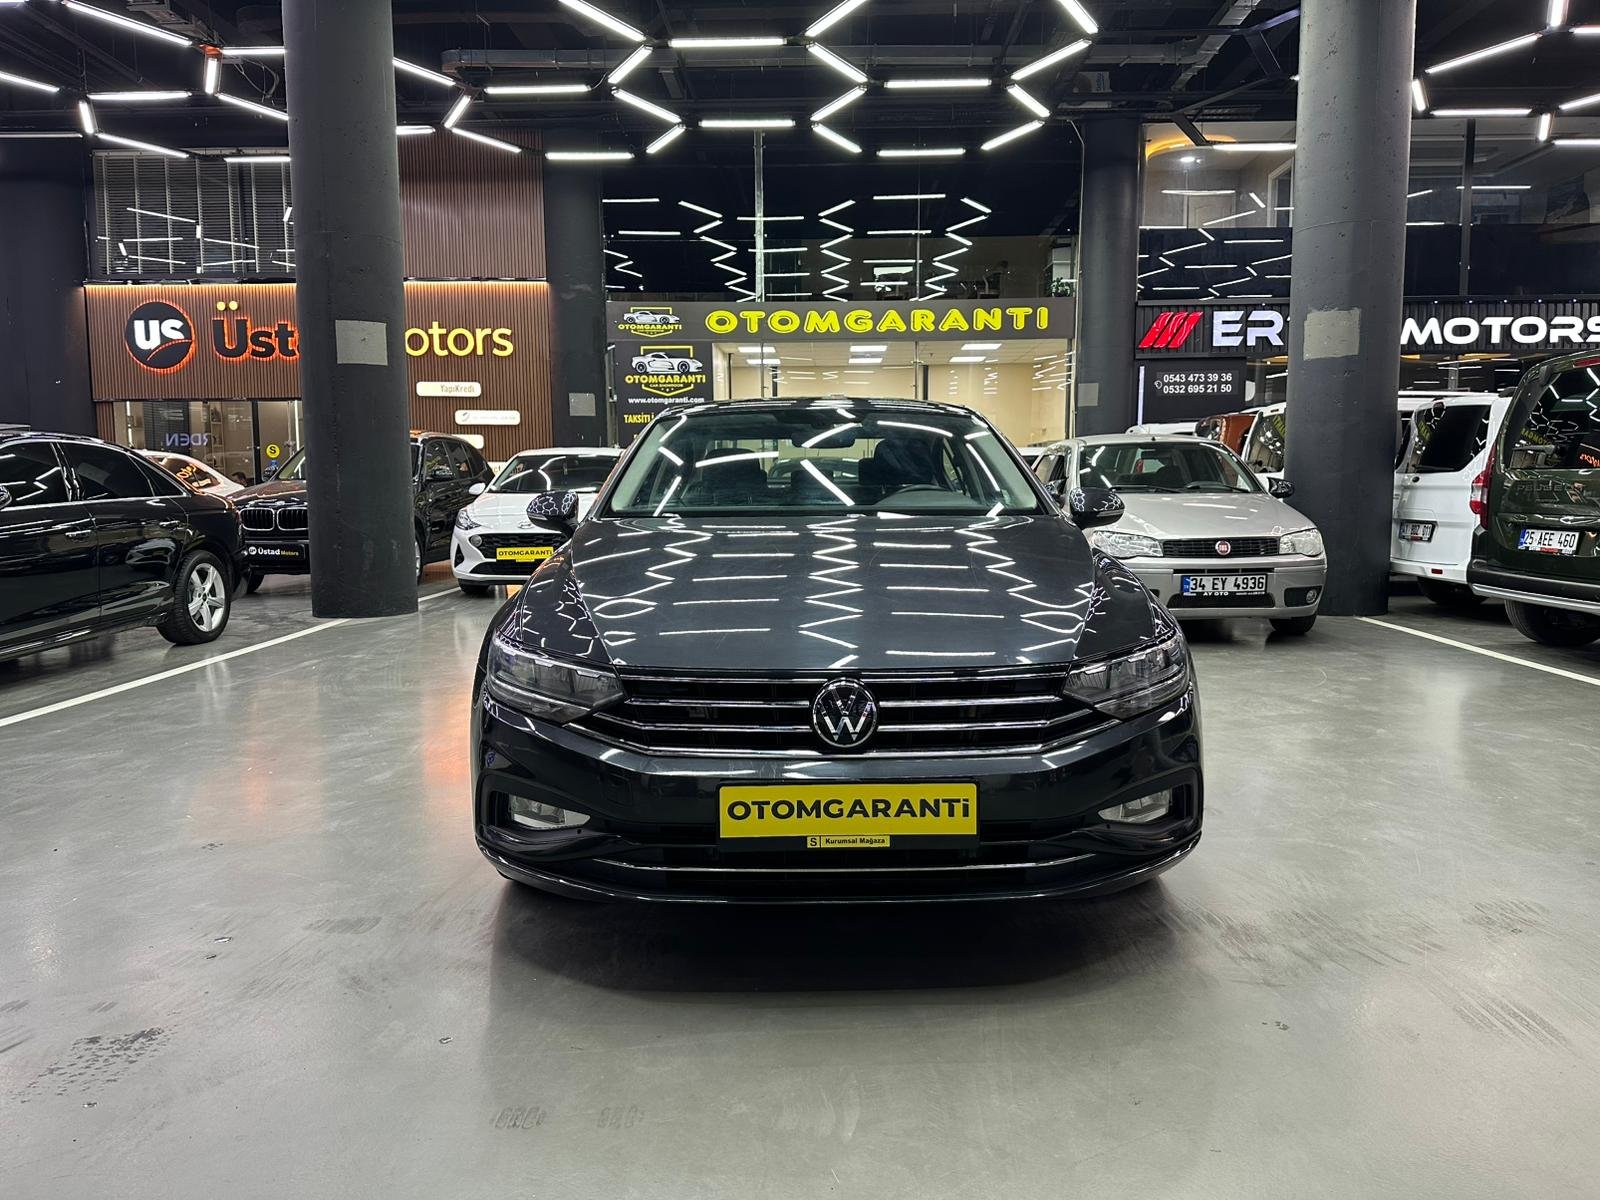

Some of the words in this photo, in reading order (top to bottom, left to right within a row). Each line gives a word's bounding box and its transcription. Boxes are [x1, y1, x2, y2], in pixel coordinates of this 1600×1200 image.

[705, 306, 1049, 334] OTOMGARANTI
[212, 300, 300, 358] Üst
[405, 321, 514, 357] otors
[1213, 310, 1290, 347] ER
[625, 374, 706, 384] OTOMGARANTI
[1163, 373, 1186, 382] 0543
[1187, 373, 1205, 382] 473
[1207, 373, 1219, 382] 39
[1220, 373, 1232, 382] 36
[1163, 385, 1185, 394] 0532
[1187, 384, 1205, 394] 695
[1206, 384, 1218, 393] 21
[1220, 384, 1232, 393] 50
[1537, 531, 1555, 547] AEE
[1558, 532, 1577, 549] 460
[258, 547, 280, 555] Üstad
[1191, 578, 1206, 591] 34
[1212, 578, 1227, 591] EY
[1233, 577, 1265, 590] 4936
[825, 837, 858, 845] Kurumsal
[859, 836, 886, 847] Mağaza
